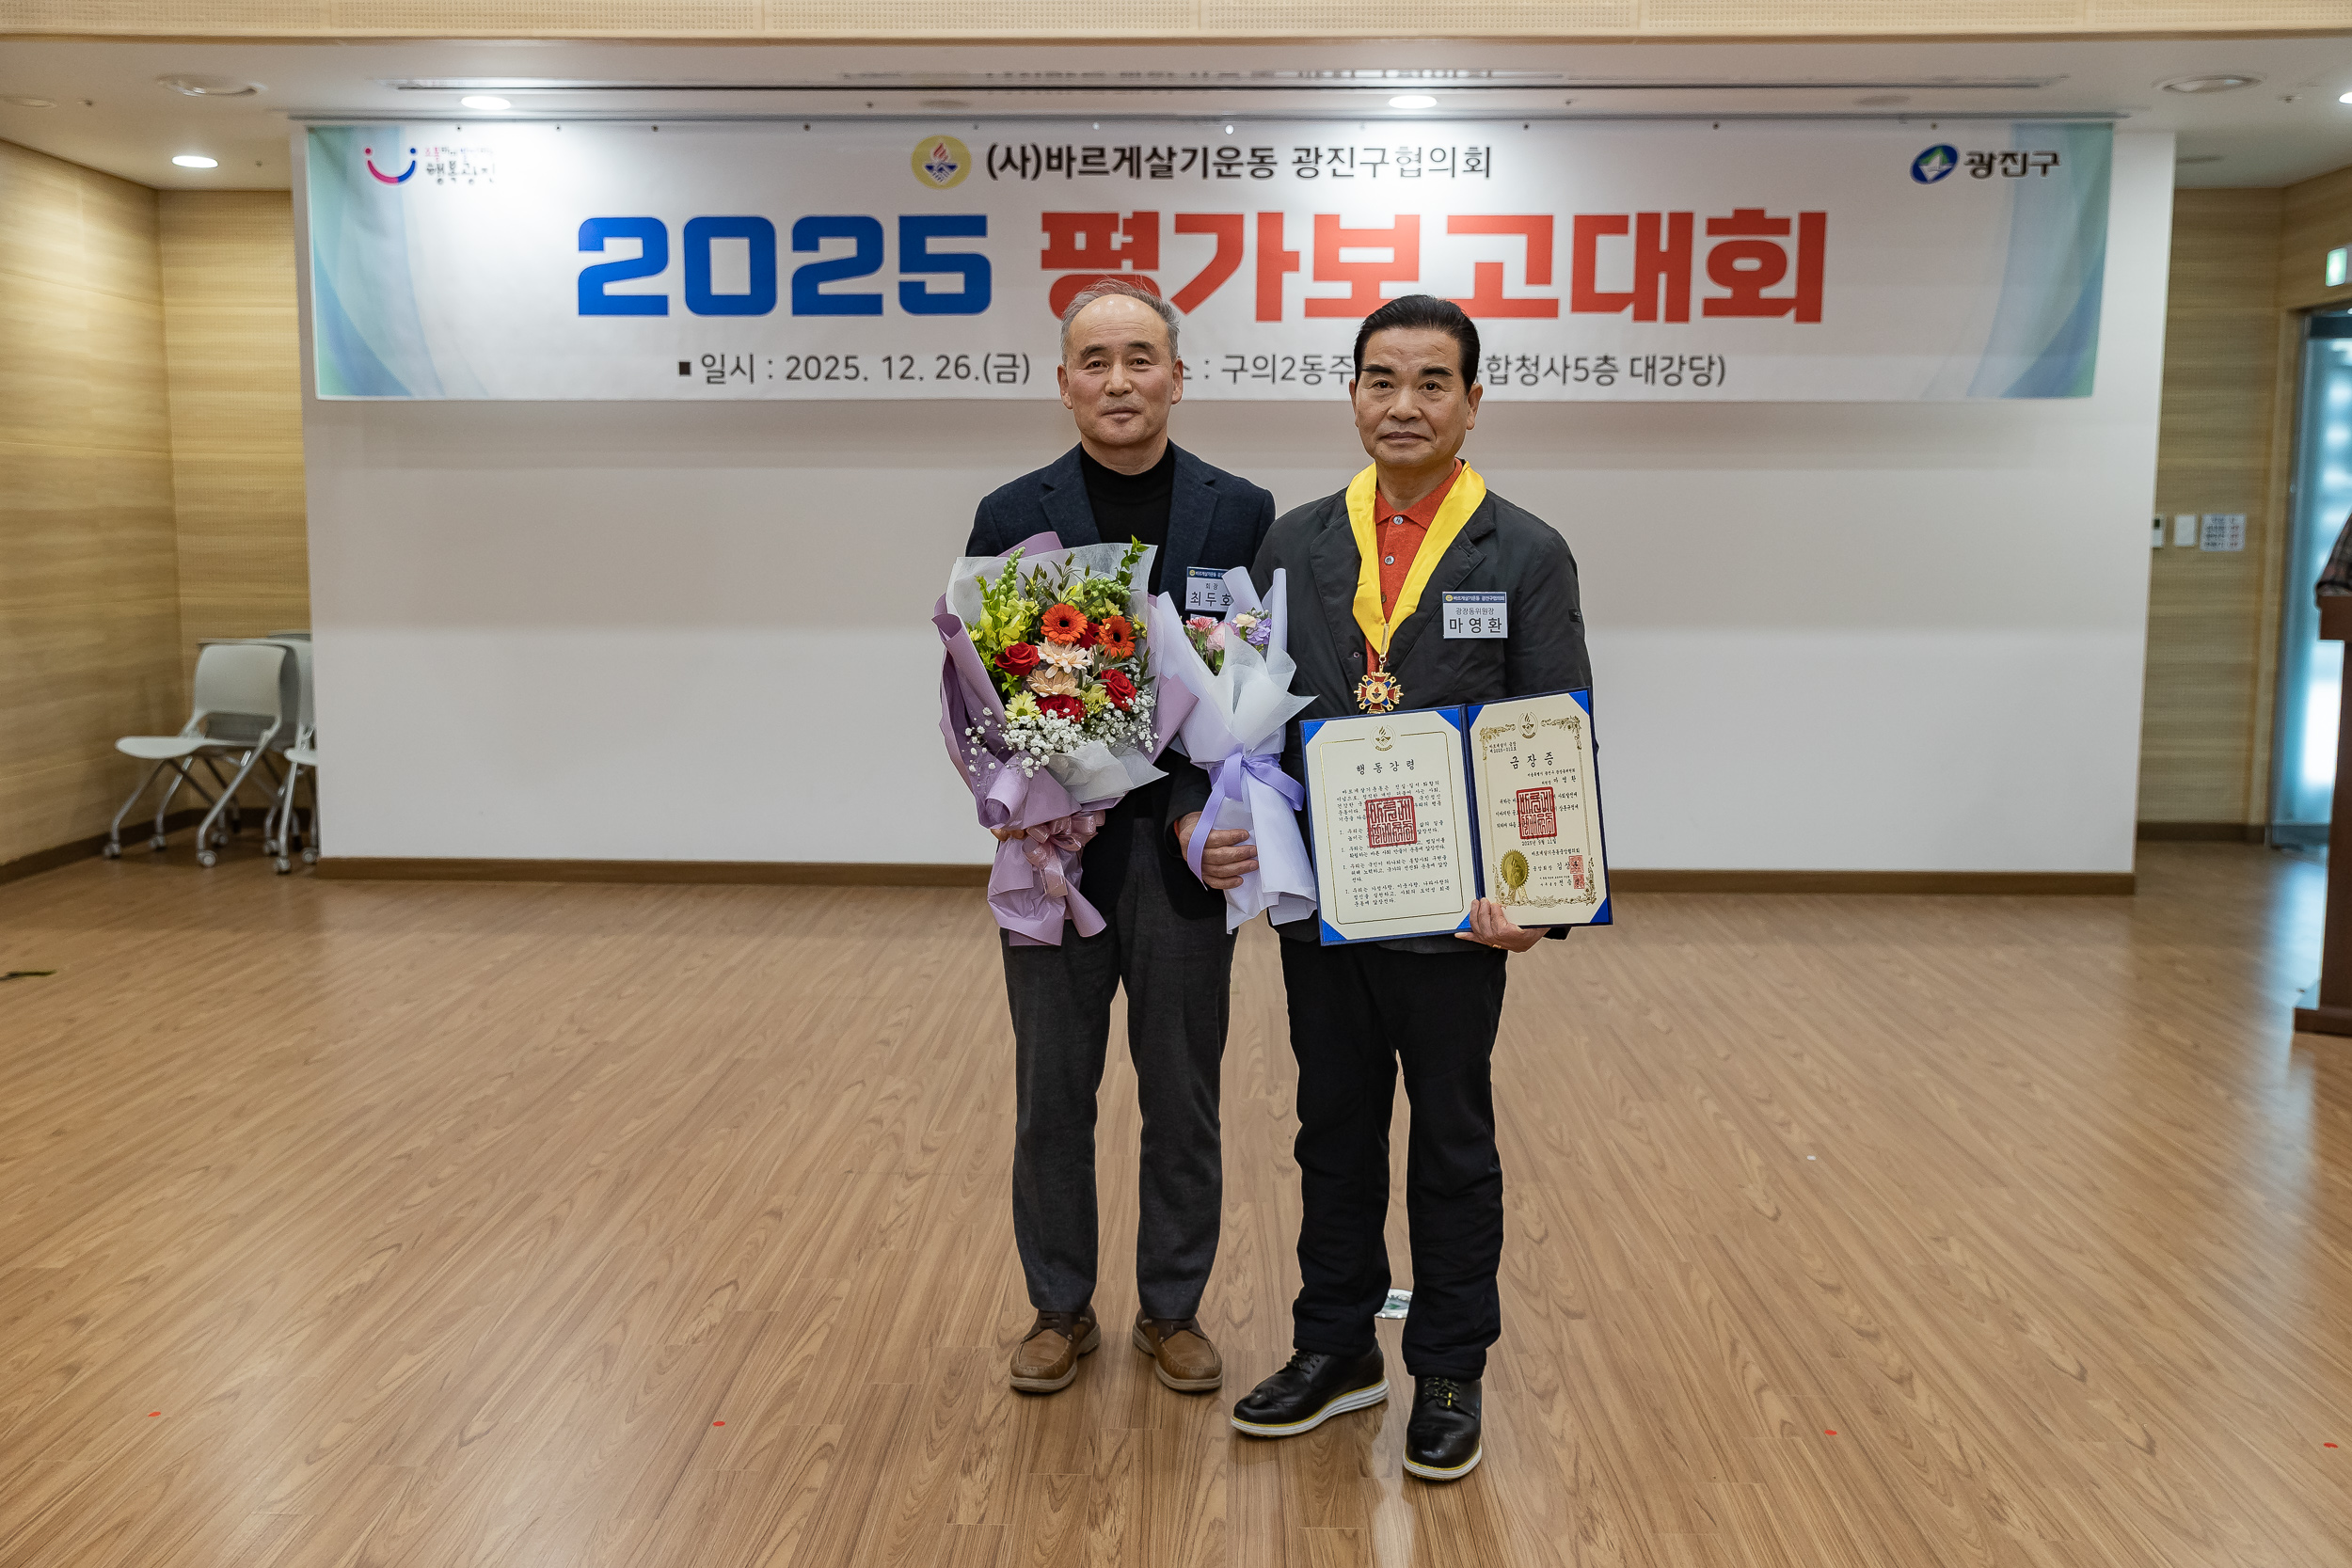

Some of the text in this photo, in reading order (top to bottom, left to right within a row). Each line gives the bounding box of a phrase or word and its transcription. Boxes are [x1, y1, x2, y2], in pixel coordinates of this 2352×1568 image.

[986, 143, 1493, 181] (사)바르게살기운동 광진구협의회
[1963, 150, 2062, 180] 광진구
[578, 207, 1827, 324] 2025 평가보고대회
[700, 353, 755, 384] 일시
[785, 356, 869, 383] 2025.
[881, 356, 924, 382] 12.
[935, 353, 1030, 386] 26.(금)
[1477, 354, 1619, 388] 합청사5층
[1630, 354, 1726, 388] 대강당)
